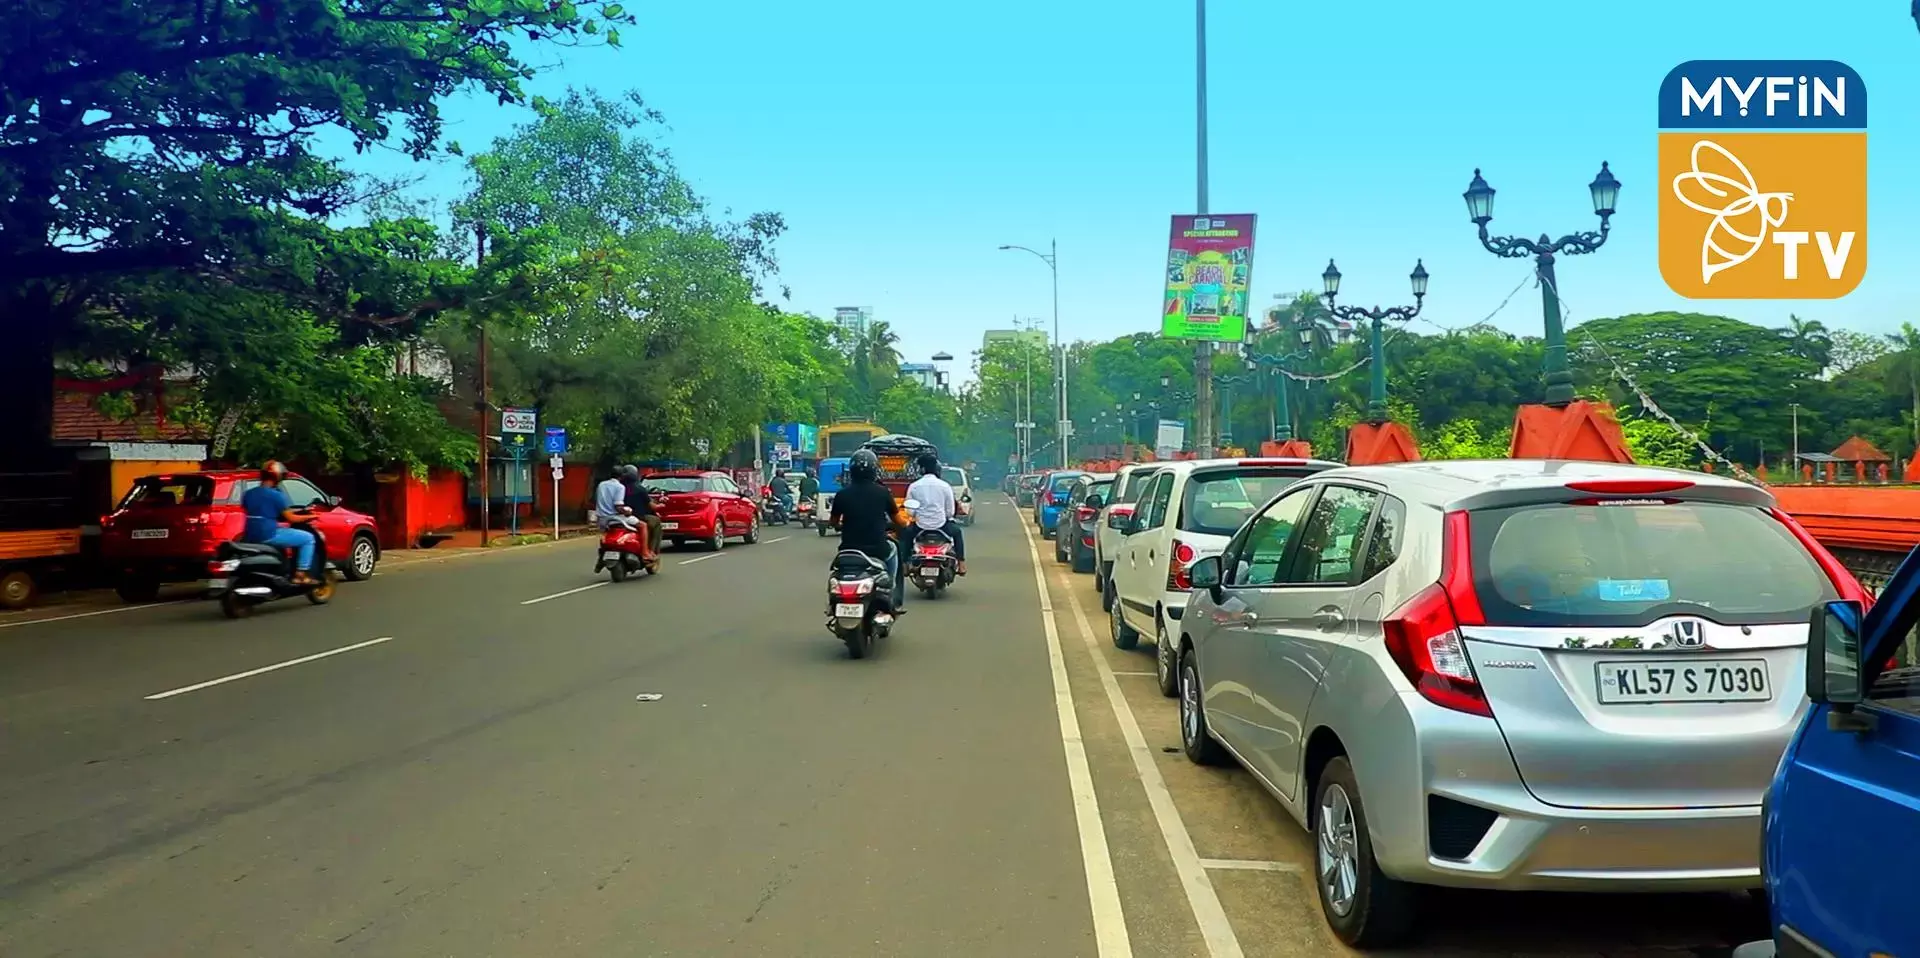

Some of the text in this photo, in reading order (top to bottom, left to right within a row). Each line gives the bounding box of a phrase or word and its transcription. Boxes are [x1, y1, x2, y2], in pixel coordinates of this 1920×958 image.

[1483, 660, 1537, 669] HONDA
[1617, 667, 1764, 695] KL57 S 7030
